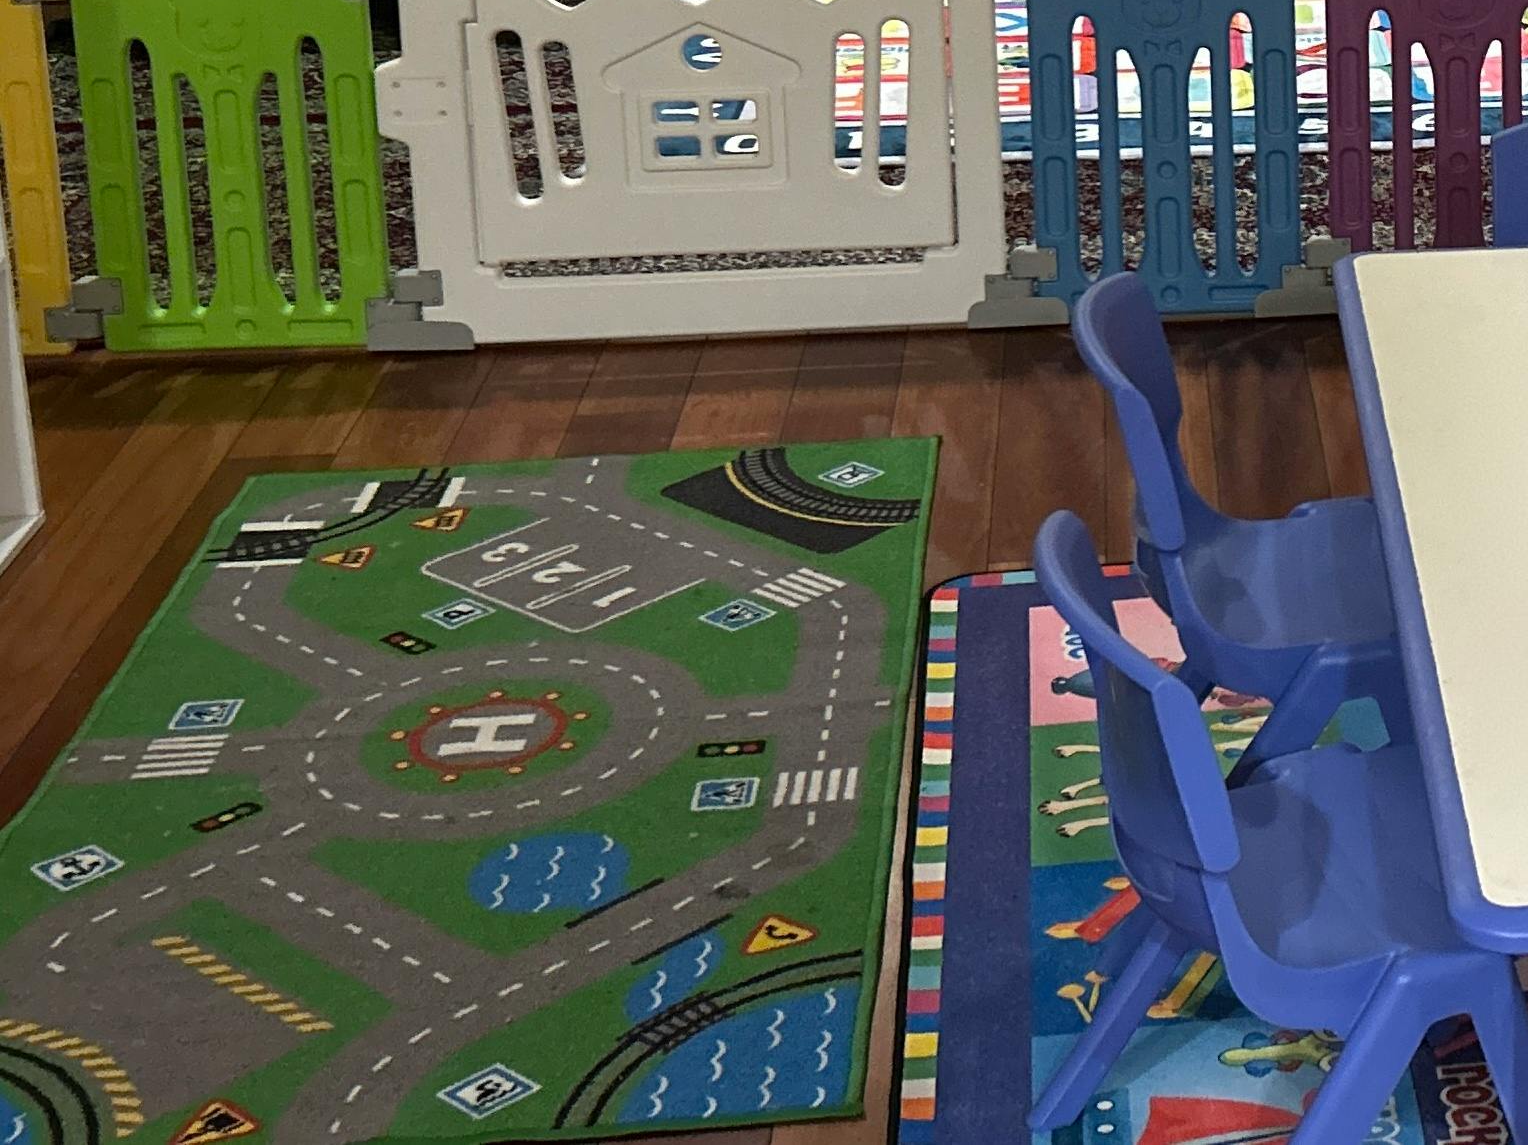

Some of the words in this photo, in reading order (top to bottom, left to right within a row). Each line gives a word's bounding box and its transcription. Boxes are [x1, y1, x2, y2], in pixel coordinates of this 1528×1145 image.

[482, 542, 529, 563] 3
[532, 560, 586, 584] 2
[592, 586, 637, 609] 1
[437, 714, 537, 756] H
